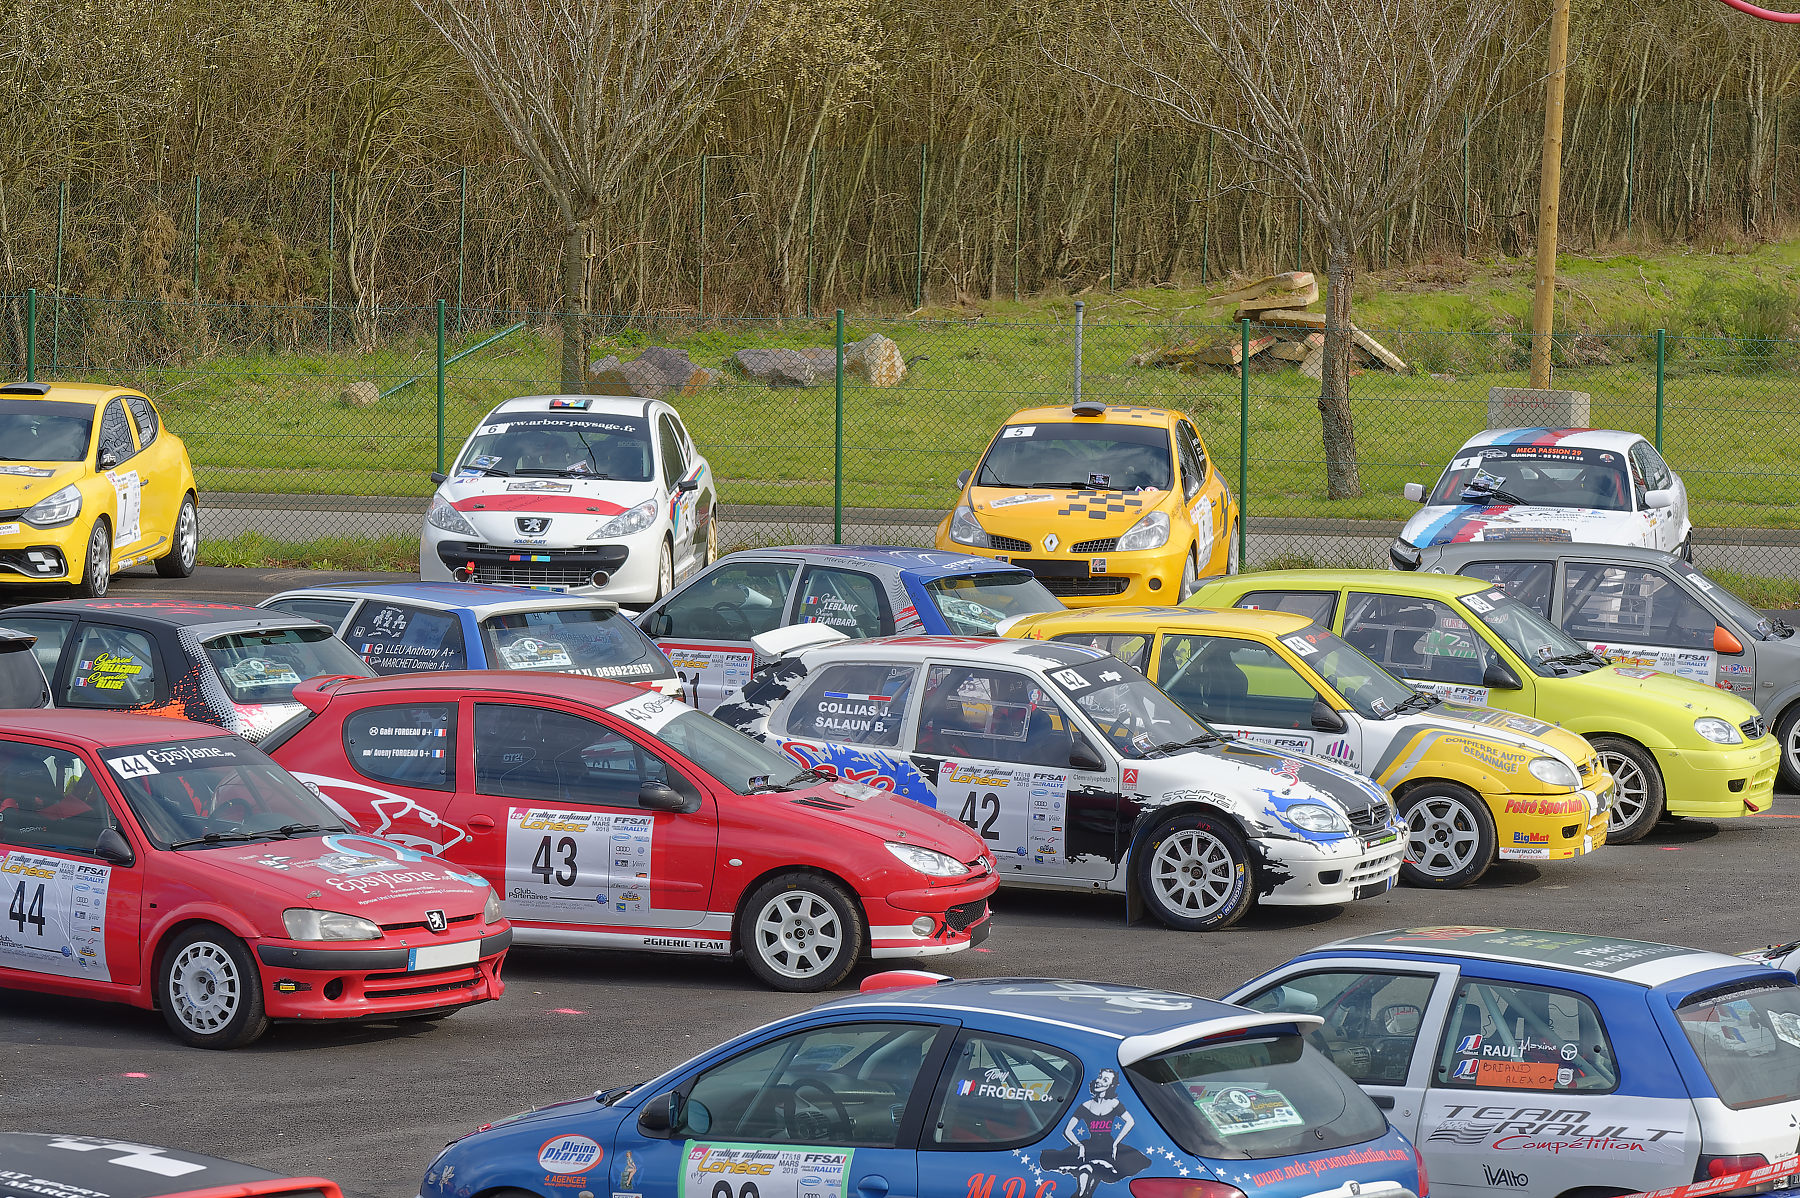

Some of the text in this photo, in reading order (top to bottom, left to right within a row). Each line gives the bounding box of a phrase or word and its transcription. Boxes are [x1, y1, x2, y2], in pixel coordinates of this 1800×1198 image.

[487, 425, 497, 434] 6
[1014, 427, 1023, 436] 5
[1460, 458, 1470, 468] 4
[824, 602, 858, 612] LEBLANC
[816, 616, 857, 626] FLAMBARD
[384, 644, 454, 658] LLEU Anthony A+
[100, 663, 142, 674] DELACOUR
[380, 658, 450, 670] MARCHET Damien A+
[96, 680, 126, 690] BLAISE
[818, 702, 892, 718] COLLIAS J.
[815, 716, 888, 732] SALAUN B.
[394, 728, 421, 736] FORGEAU
[392, 749, 418, 757] FORGEAU
[1446, 738, 1526, 762] DOMPIERRE AUTO
[1464, 746, 1517, 772] DEPANNAGE
[120, 757, 150, 775] 44
[949, 766, 1010, 788] Lohéac
[983, 768, 1014, 777] national
[1504, 799, 1538, 814] Poiré
[1538, 799, 1568, 816] Sport
[530, 811, 592, 823] rallye national
[958, 792, 1000, 840] 42
[520, 812, 589, 833] Lohéac
[1513, 832, 1550, 844] BigMat
[10, 855, 60, 868] rallye national
[531, 836, 578, 887] 43
[59, 868, 74, 876] MARS
[84, 876, 106, 884] RALLYE
[508, 892, 548, 901] Partenaires
[1222, 878, 1245, 915] MICHELIN
[9, 880, 46, 936] 44
[644, 938, 724, 950] 2GHERIC TEAM
[1482, 1044, 1524, 1058] RAULT
[1483, 1062, 1532, 1074] BRIAND
[984, 1068, 1010, 1083] Tony
[1506, 1076, 1535, 1084] ALEX
[978, 1084, 1035, 1102] FROGER
[1234, 1094, 1248, 1104] 30
[1442, 1104, 1592, 1123] TEAM
[1090, 1120, 1112, 1130] MDC
[1492, 1121, 1685, 1143] RAULT
[1492, 1135, 1646, 1155] Compétition
[542, 1148, 594, 1162] Phares
[711, 1148, 780, 1160] rallye national
[698, 1150, 774, 1176] Lohéac
[778, 1160, 800, 1168] MARS
[1252, 1147, 1409, 1188] www.mdc-personnalisation.com
[1750, 1163, 1774, 1179] INTERDIT
[1773, 1162, 1782, 1175] AU
[1782, 1156, 1799, 1172] PUBLIC
[782, 1166, 798, 1174] 2018
[813, 1166, 842, 1174] RALLYE
[551, 1175, 587, 1184] AGENCES
[1687, 1174, 1741, 1192] INTERDIT AU PUBLIC
[28, 1178, 110, 1198] SPORT
